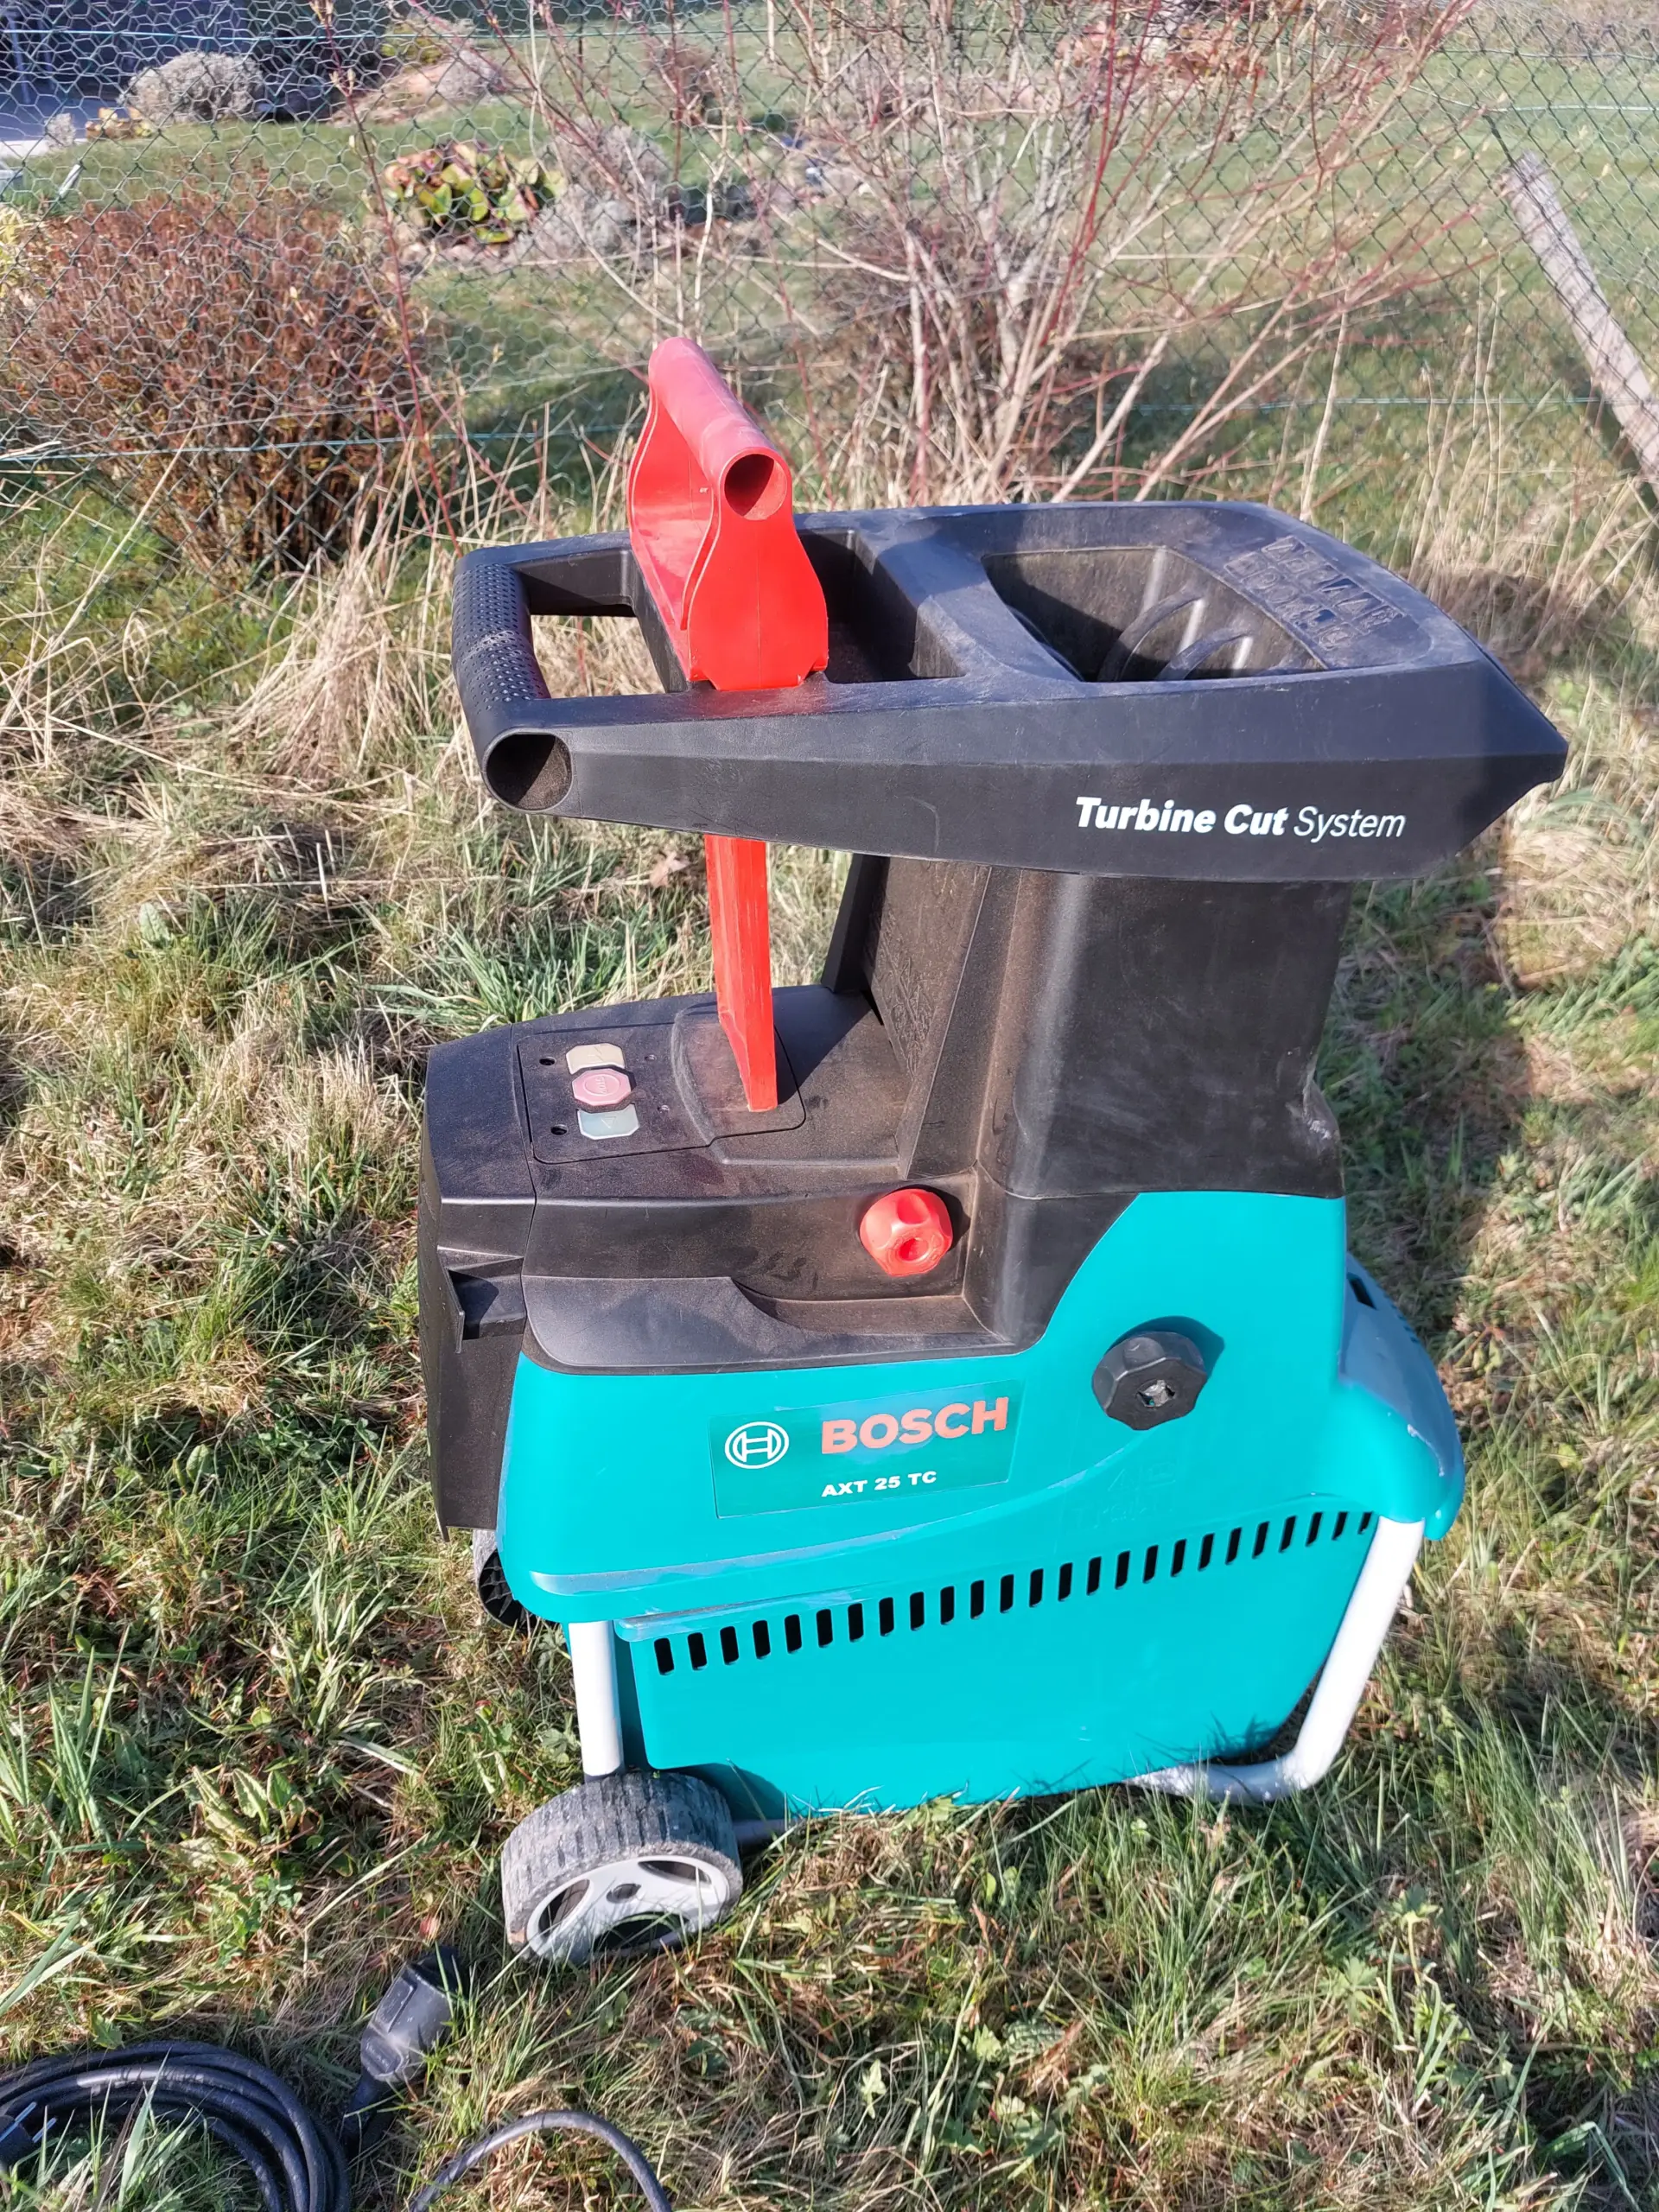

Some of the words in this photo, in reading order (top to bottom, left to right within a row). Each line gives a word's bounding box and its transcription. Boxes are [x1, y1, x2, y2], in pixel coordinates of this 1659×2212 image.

[1076, 797, 1216, 833] Turbine
[1224, 804, 1289, 836] Cut
[1294, 806, 1406, 842] System
[594, 1076, 608, 1094] STOP
[822, 1397, 1008, 1454] BOSCH
[822, 1480, 868, 1497] AXT
[874, 1476, 901, 1491] 25
[908, 1471, 937, 1485] TC
